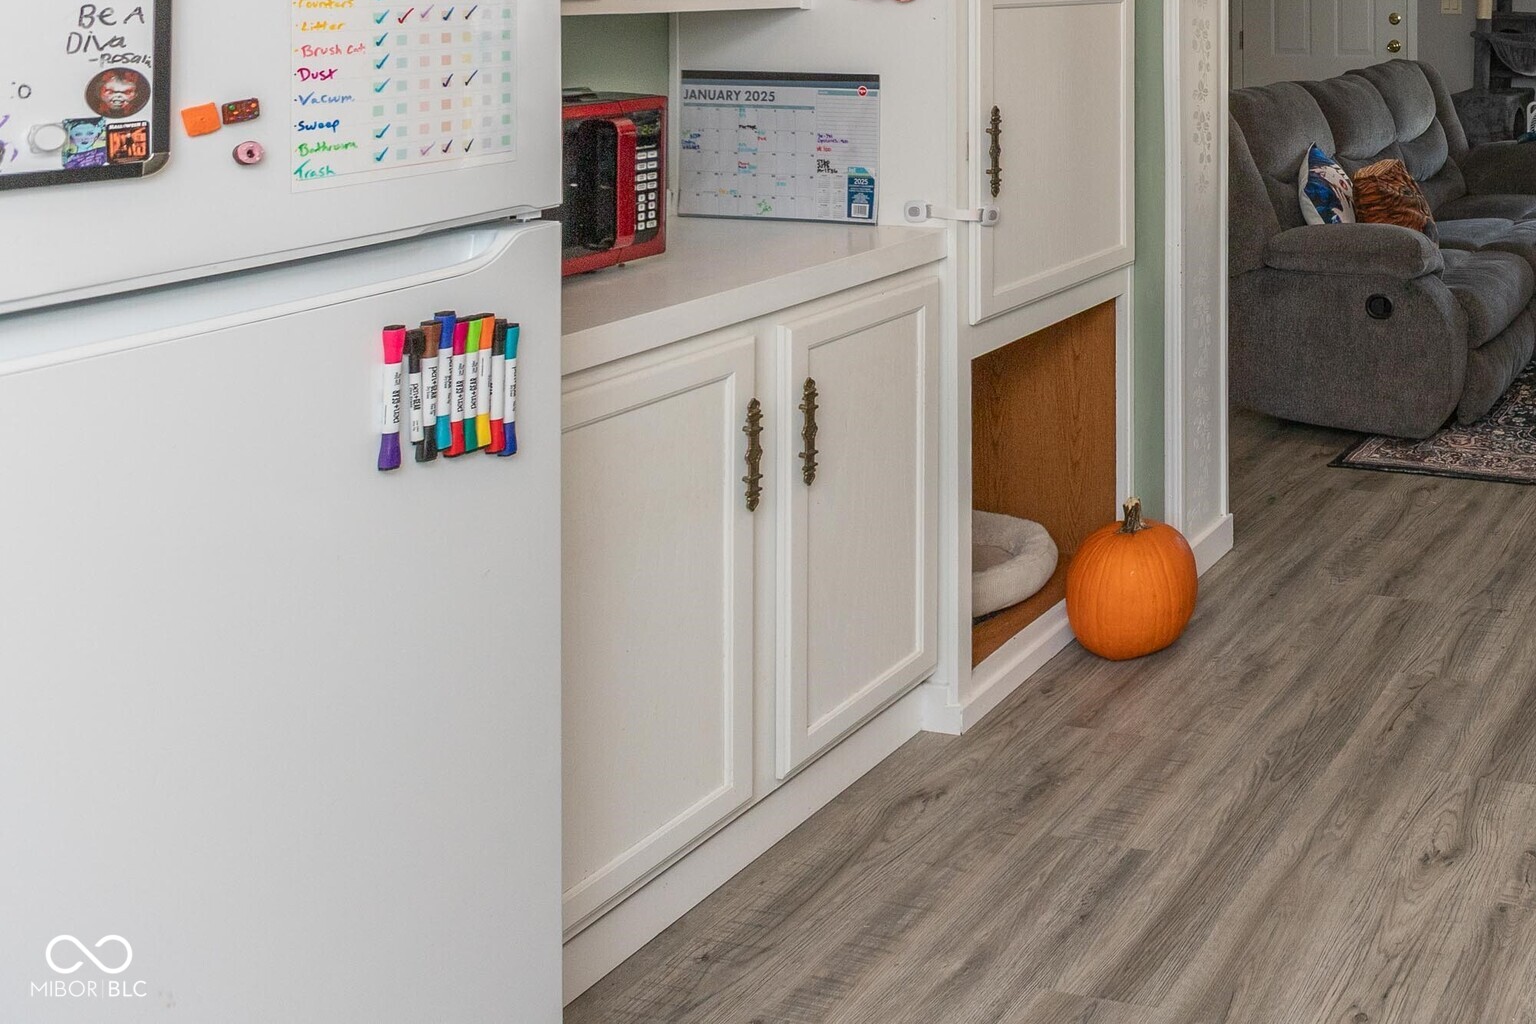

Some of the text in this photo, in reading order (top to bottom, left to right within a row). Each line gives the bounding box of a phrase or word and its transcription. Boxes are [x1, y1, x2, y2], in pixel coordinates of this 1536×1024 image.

[123, 6, 145, 24] A
[301, 44, 342, 58] Brush
[297, 68, 338, 82] Dust
[683, 88, 776, 102] JANUARY 2025
[298, 120, 340, 133] Sweep
[294, 159, 336, 178] Trash
